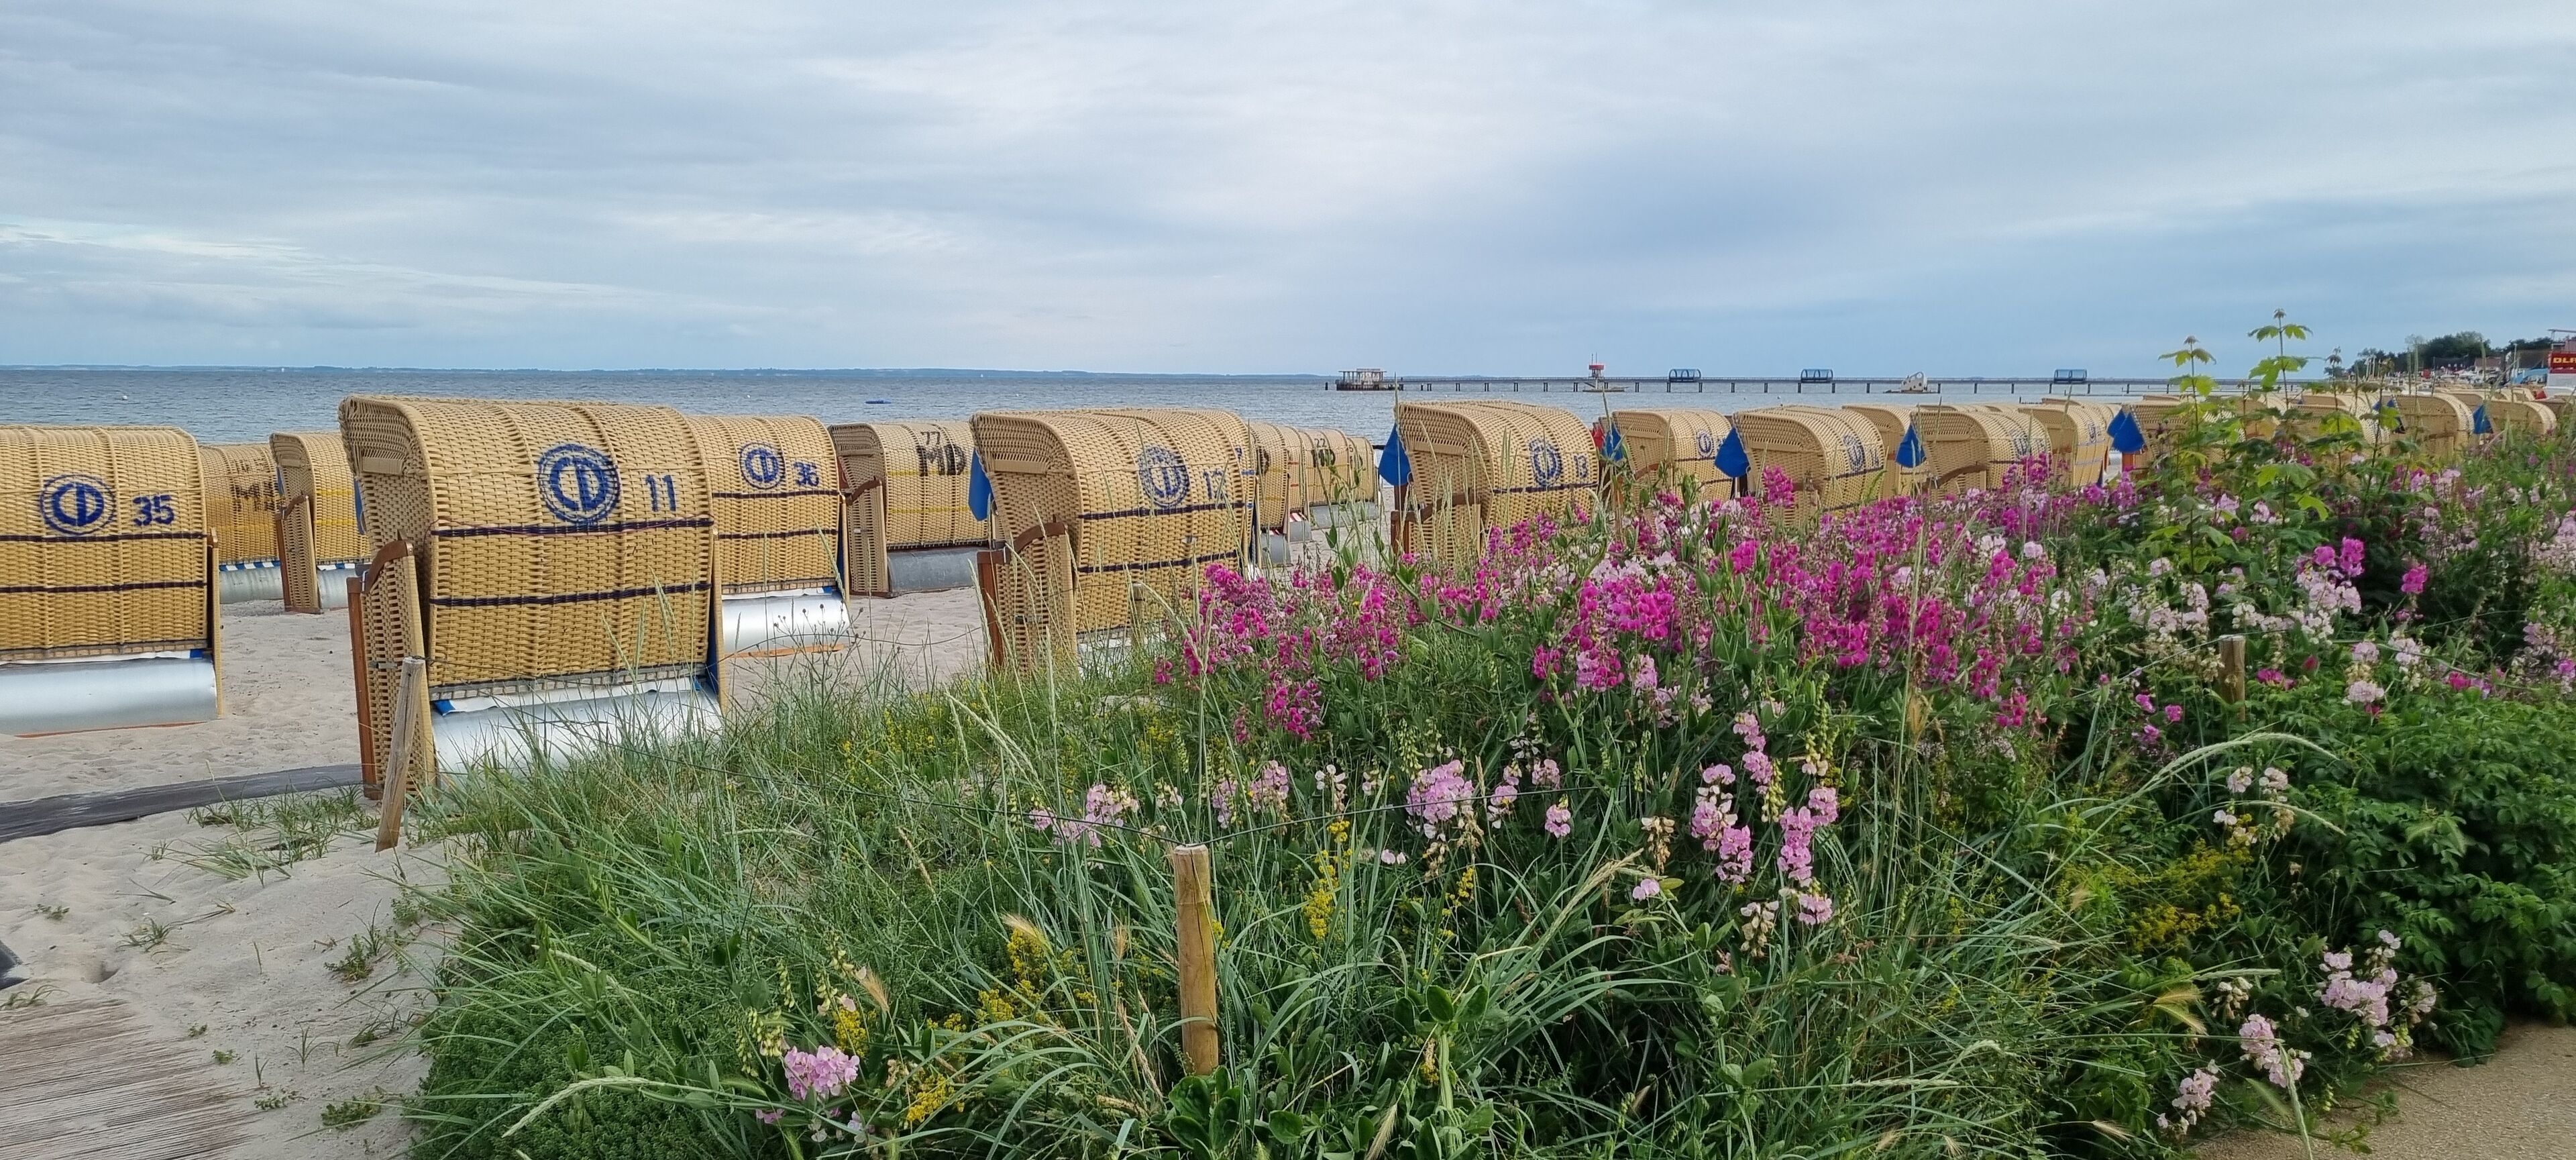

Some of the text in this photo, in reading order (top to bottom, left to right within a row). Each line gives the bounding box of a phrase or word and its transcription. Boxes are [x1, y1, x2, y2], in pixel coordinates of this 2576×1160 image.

[1314, 438, 1327, 448] 22
[793, 461, 819, 486] 36
[916, 444, 966, 476] MD
[645, 474, 676, 512] 11
[133, 494, 174, 527] 35
